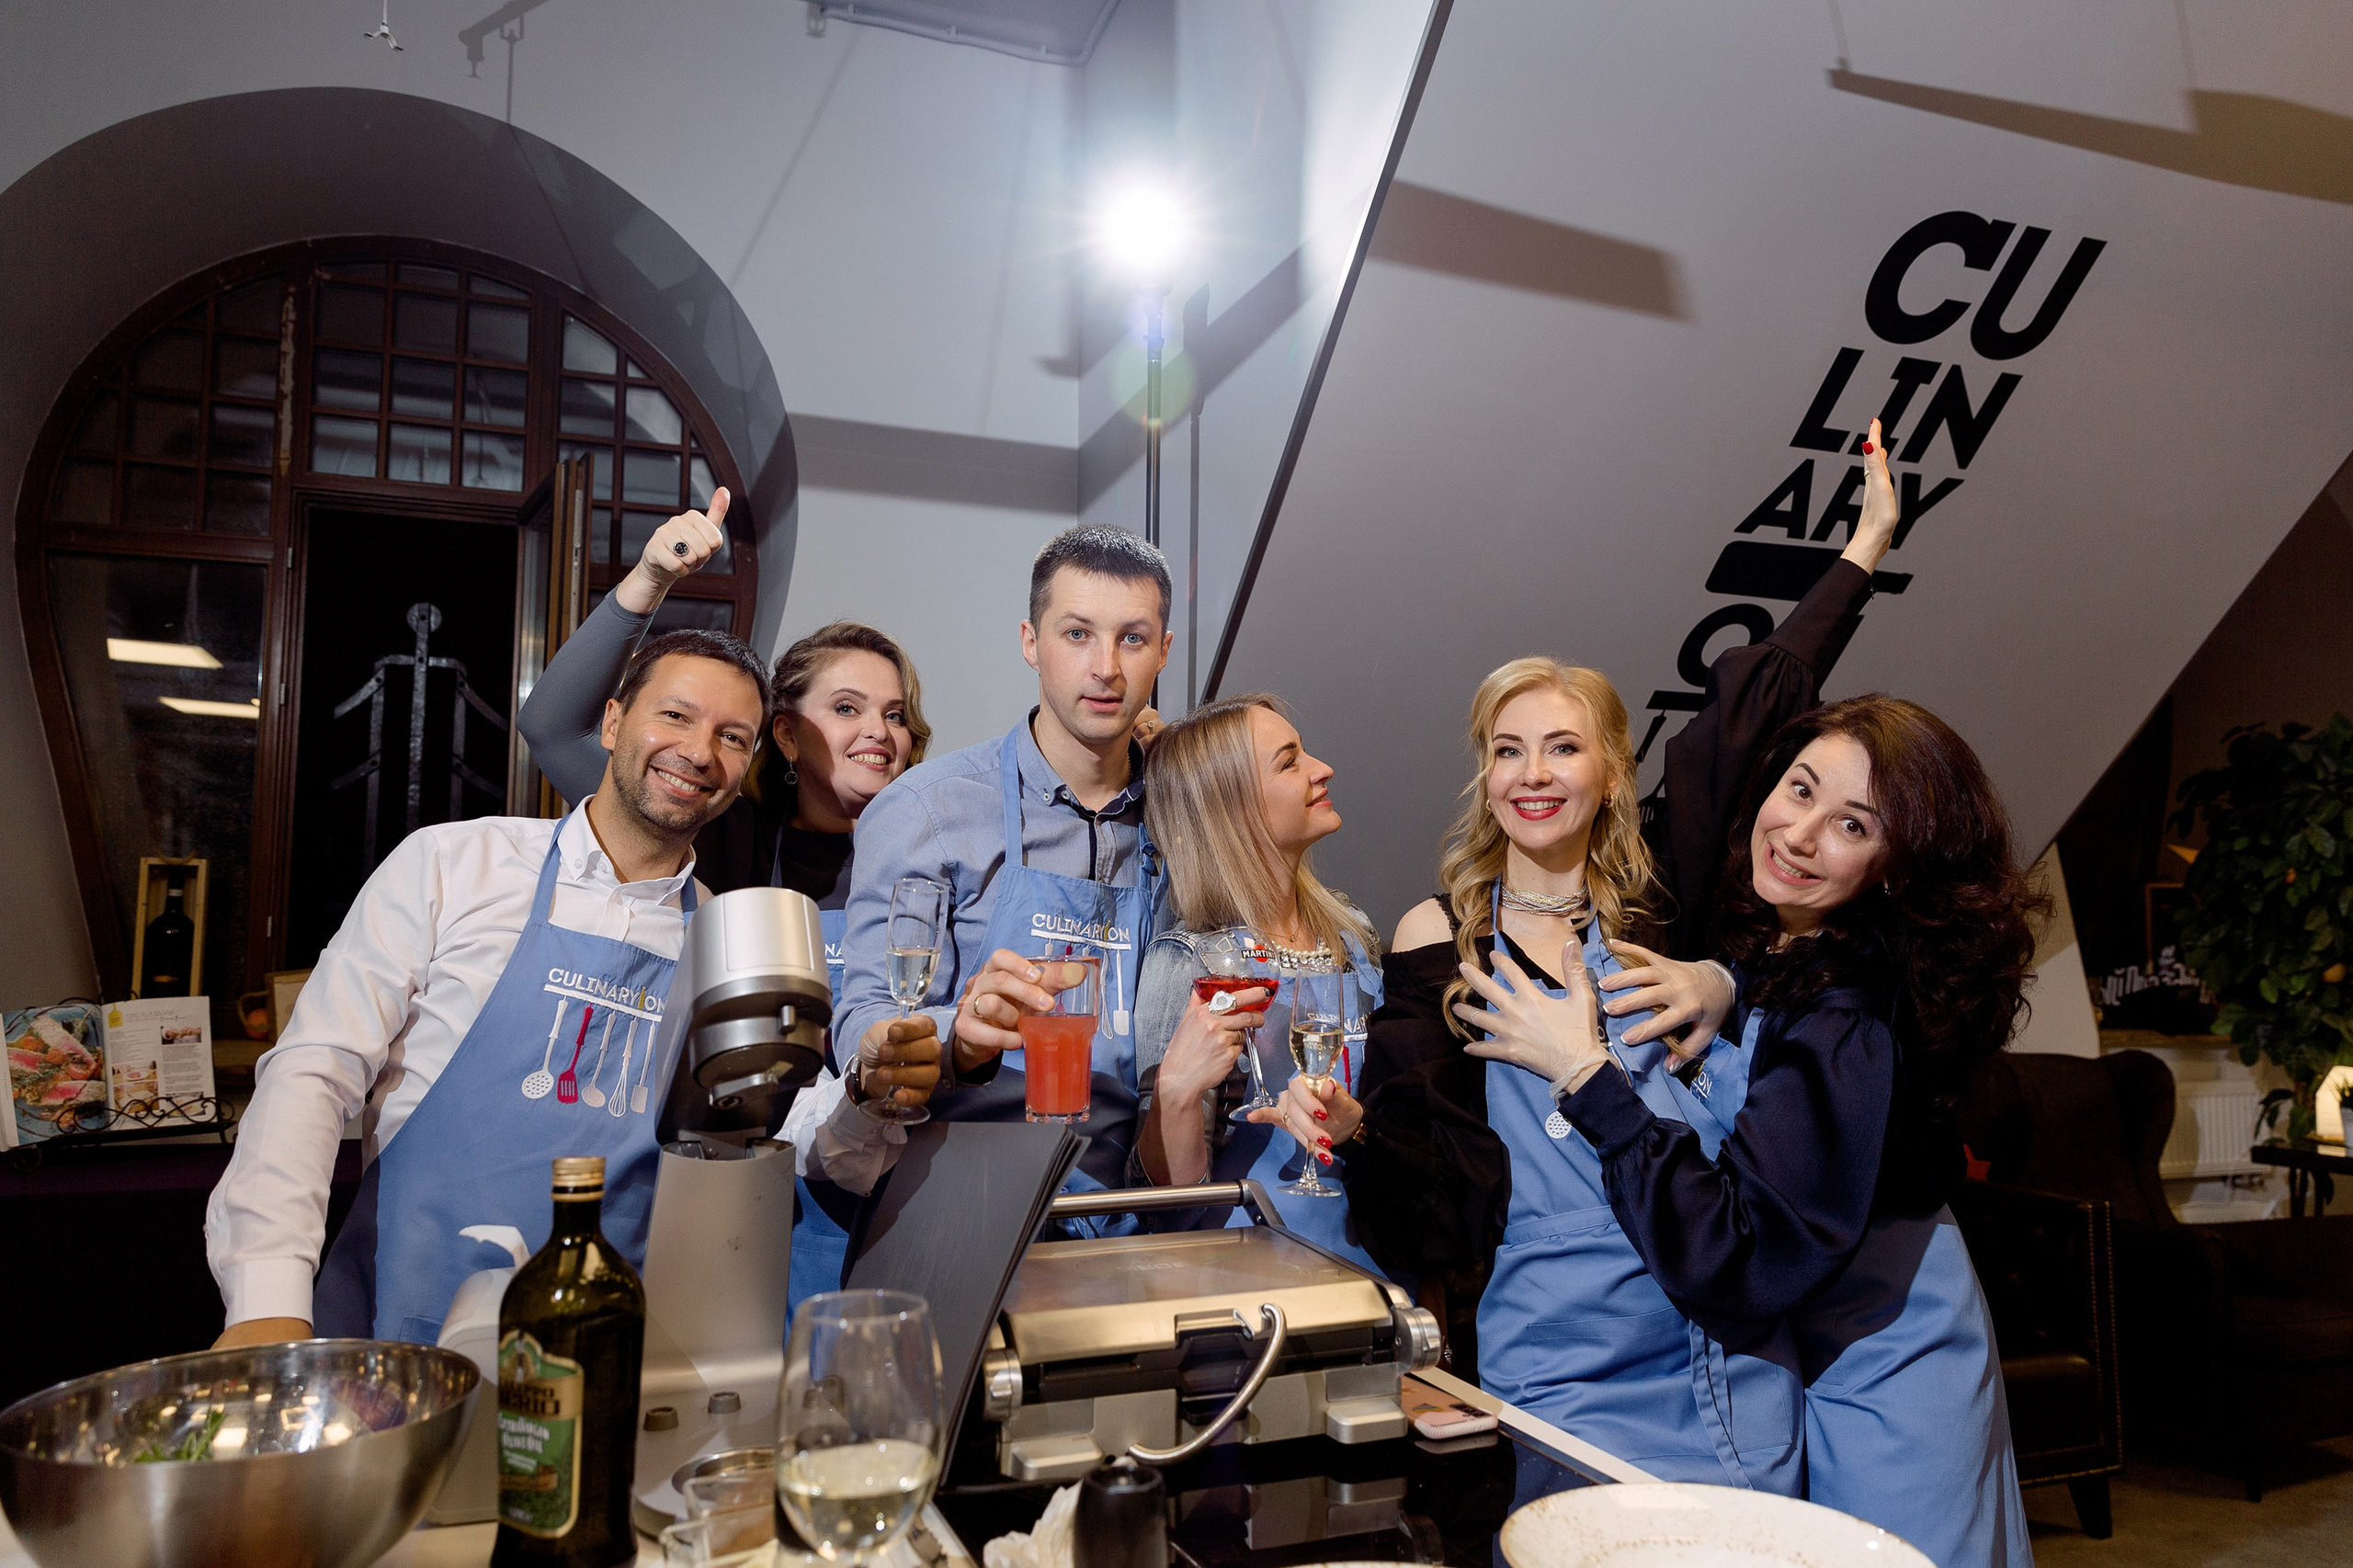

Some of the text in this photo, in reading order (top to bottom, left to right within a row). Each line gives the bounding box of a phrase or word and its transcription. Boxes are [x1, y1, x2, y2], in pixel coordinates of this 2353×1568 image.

[1865, 210, 2108, 360] CU
[1790, 347, 2023, 470] LIN
[1733, 459, 1964, 550] ARY
